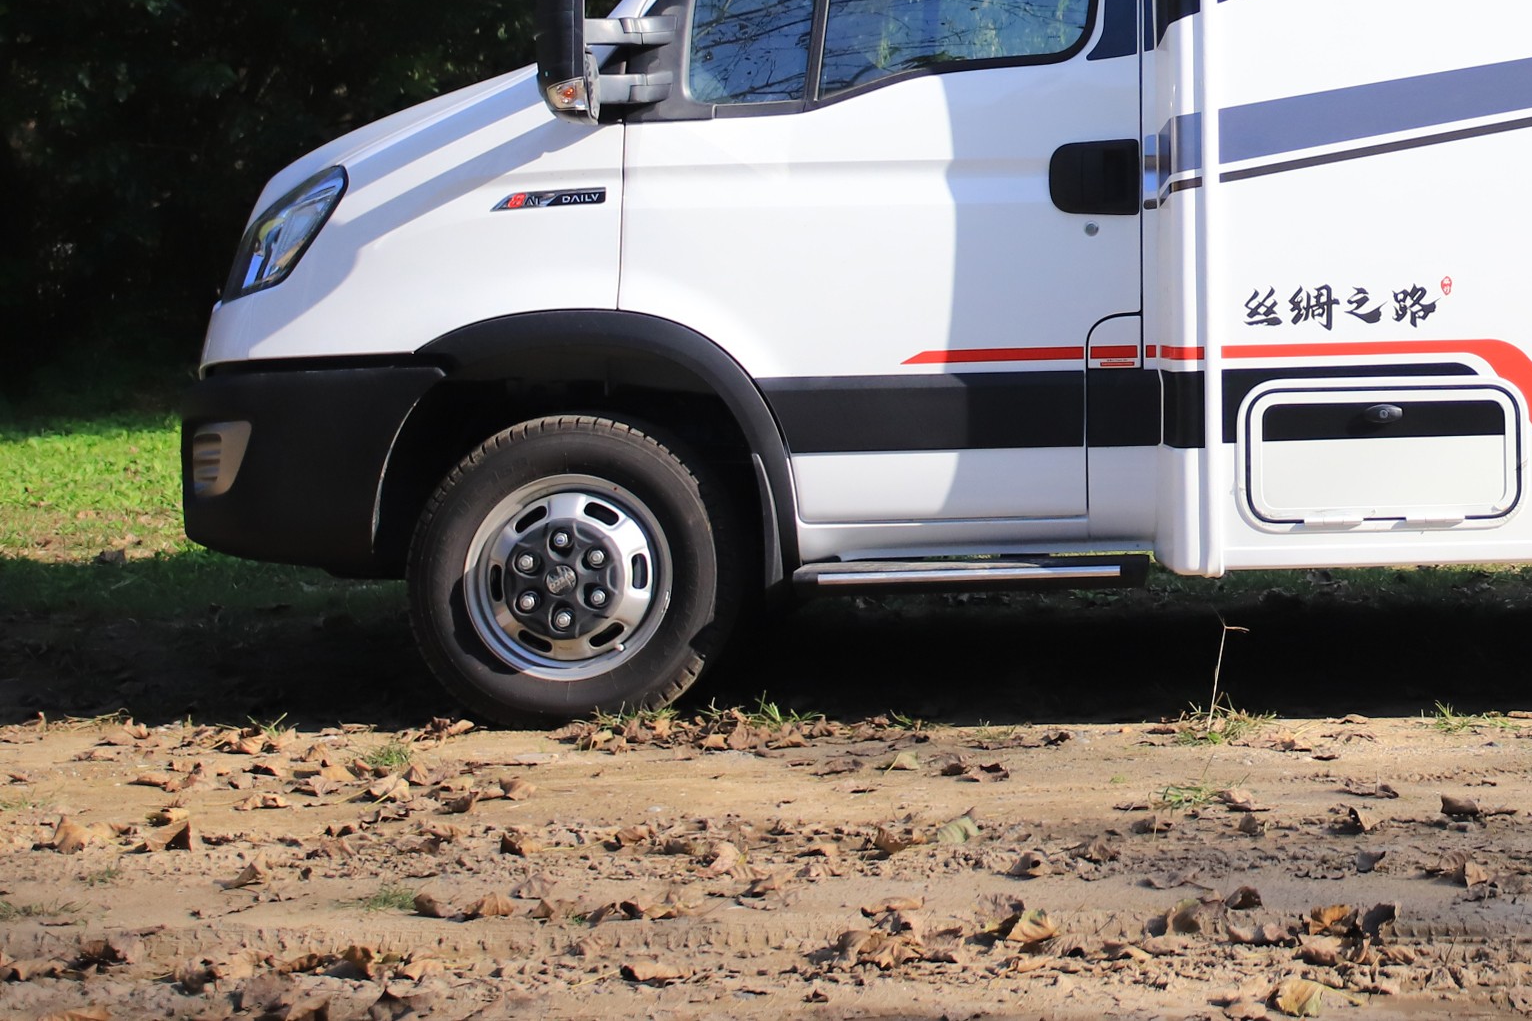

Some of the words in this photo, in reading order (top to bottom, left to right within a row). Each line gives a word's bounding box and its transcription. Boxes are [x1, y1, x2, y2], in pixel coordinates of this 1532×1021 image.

[562, 193, 600, 204] DAILY
[1243, 283, 1441, 331] 丝绸之路
